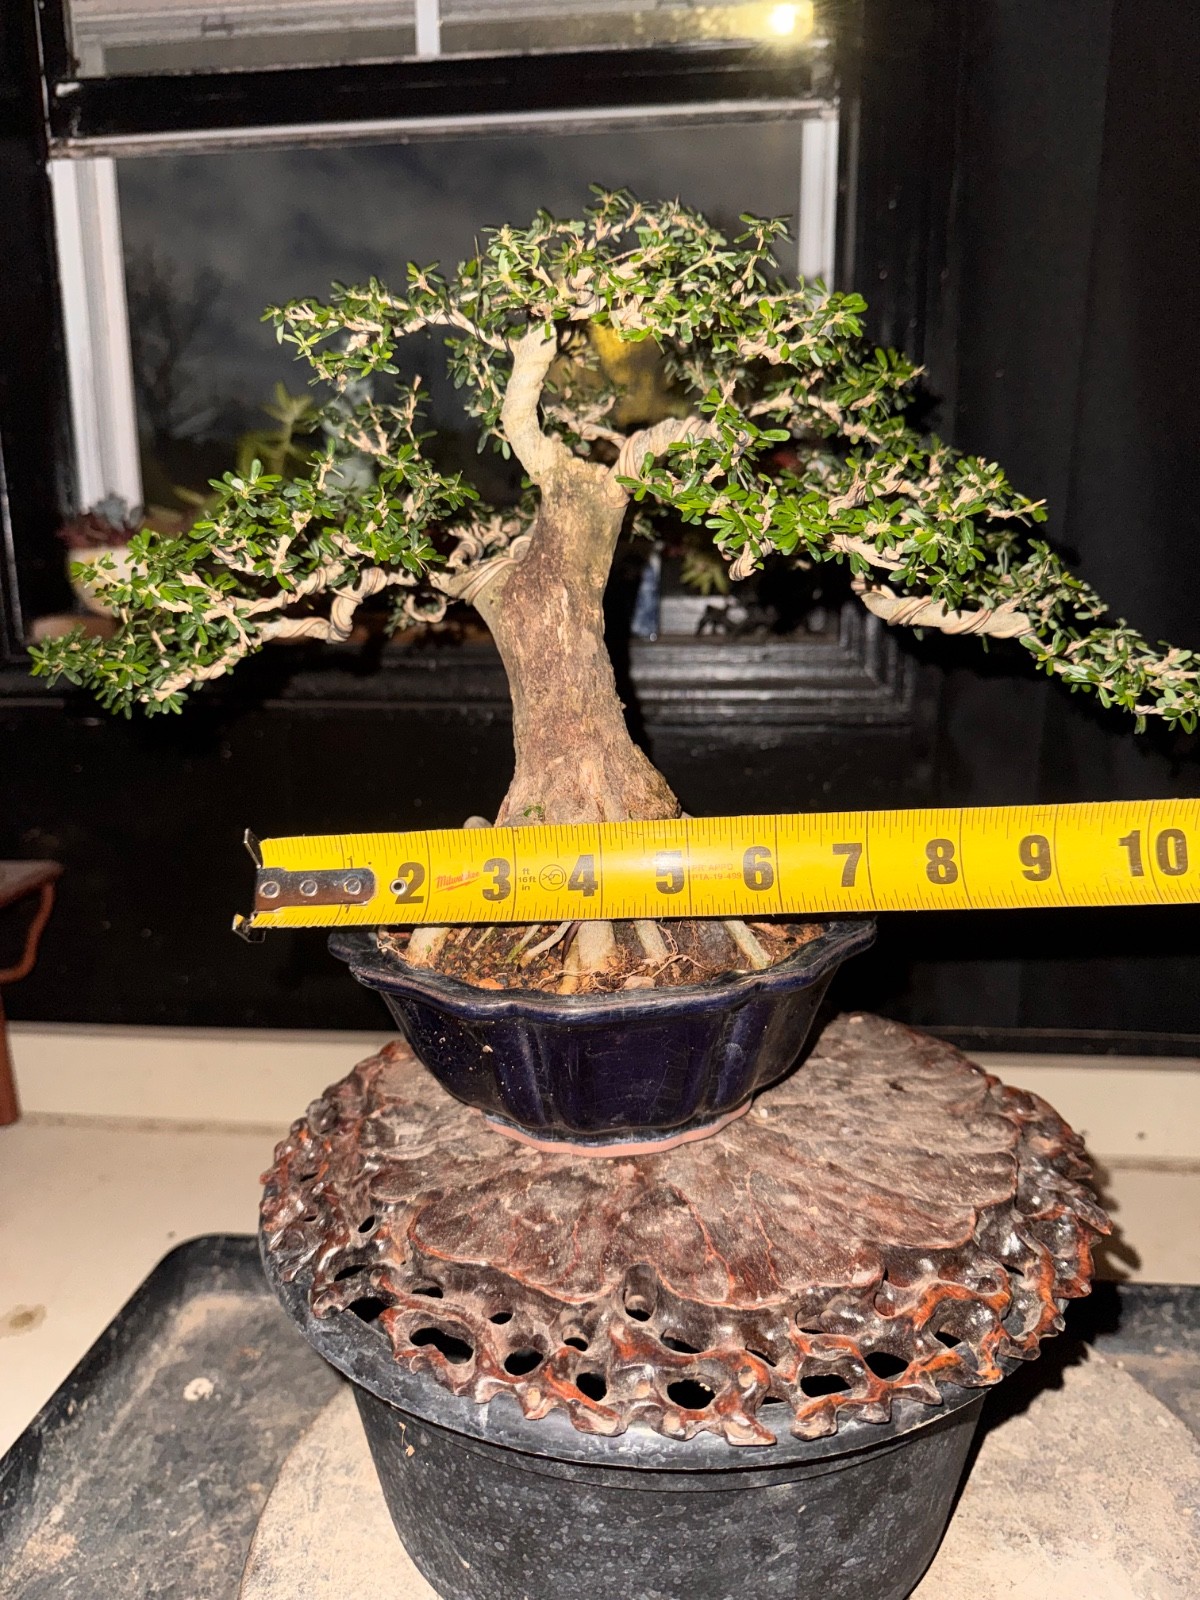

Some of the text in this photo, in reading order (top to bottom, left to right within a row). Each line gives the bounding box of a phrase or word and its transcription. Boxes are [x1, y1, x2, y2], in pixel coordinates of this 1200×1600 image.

[655, 849, 685, 894] 5
[742, 845, 775, 891] 6
[832, 842, 863, 888] 7
[924, 838, 959, 885] 8
[1018, 834, 1053, 882] 9
[1118, 828, 1189, 877] 10
[395, 861, 426, 905] 2
[435, 870, 480, 889] Milwakee
[482, 858, 511, 901] 3
[567, 854, 599, 897] 4
